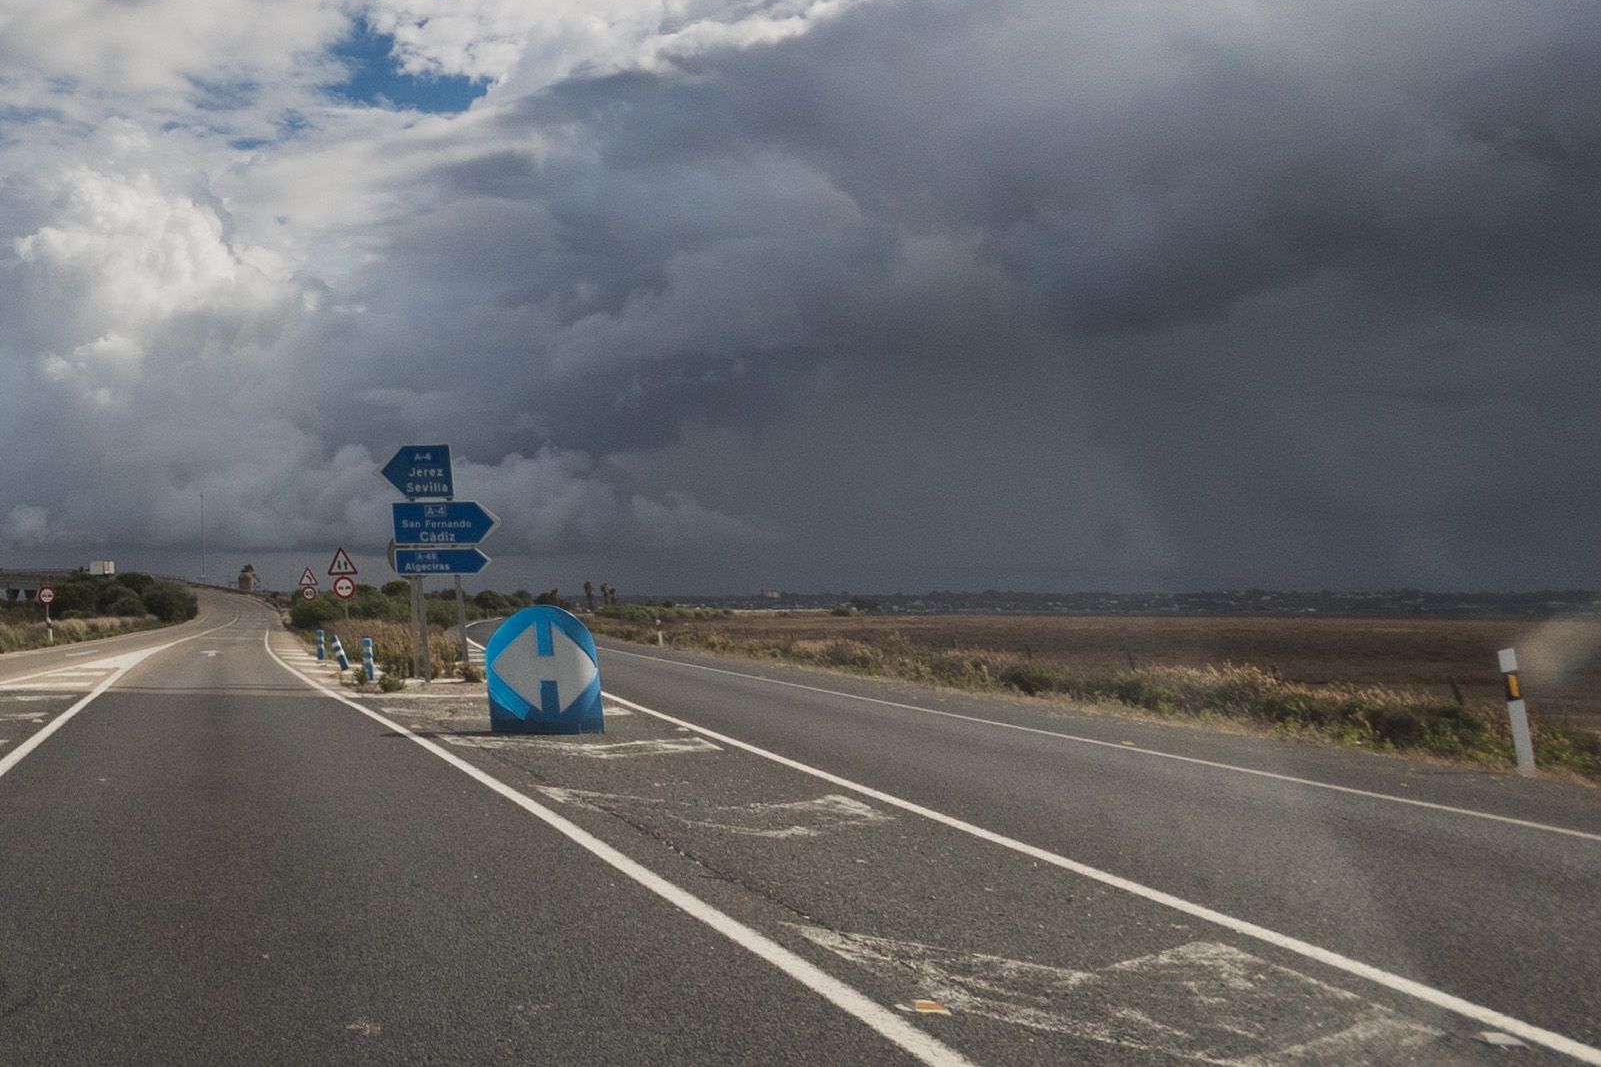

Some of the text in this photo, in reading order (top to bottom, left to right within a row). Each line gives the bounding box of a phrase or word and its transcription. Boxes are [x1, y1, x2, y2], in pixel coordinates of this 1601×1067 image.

[414, 453, 432, 461] A-4
[408, 467, 444, 477] Jerez
[406, 482, 449, 493] Sevilla
[427, 507, 445, 515] A-4
[402, 519, 472, 528] San Fernando
[405, 563, 450, 573] Algeciras
